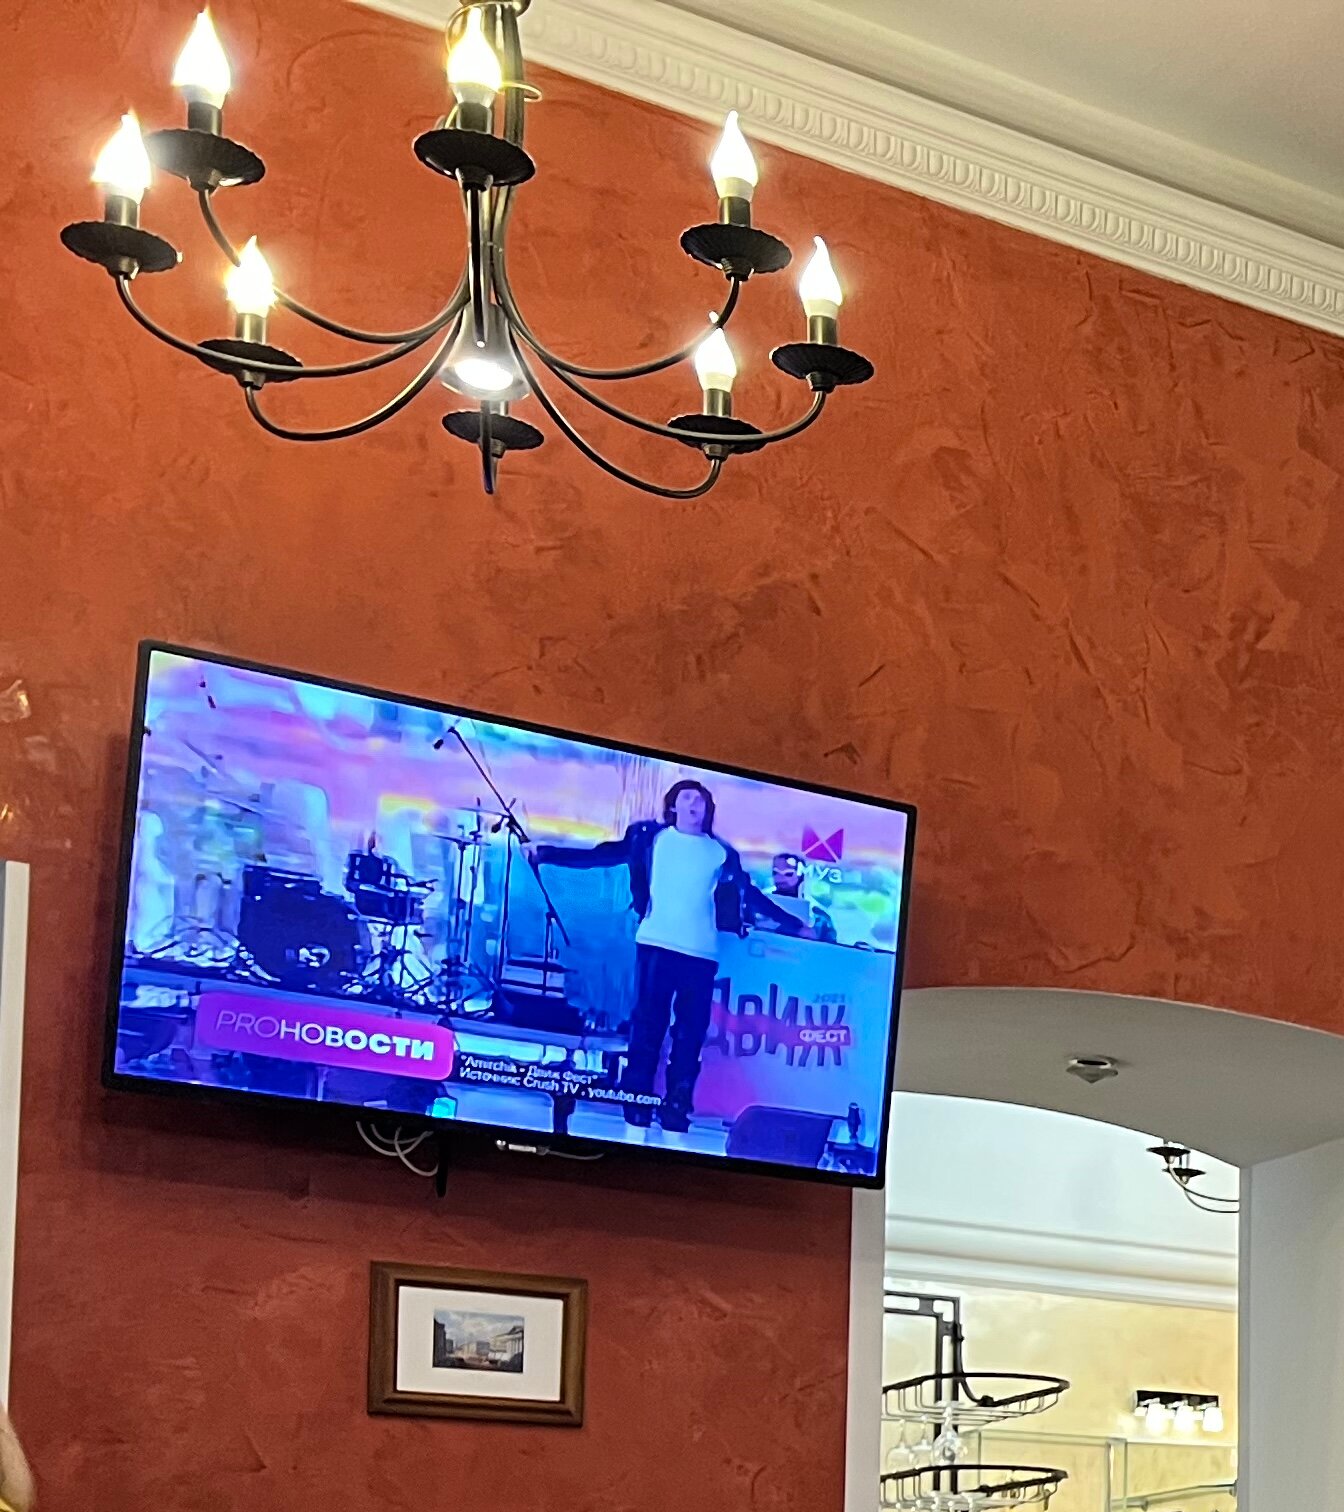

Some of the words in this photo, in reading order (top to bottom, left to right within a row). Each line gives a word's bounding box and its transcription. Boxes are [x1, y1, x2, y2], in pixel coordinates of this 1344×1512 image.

[796, 861, 842, 884] МУЗ
[800, 1029, 848, 1043] ФЕСТ
[561, 1080, 580, 1095] TV
